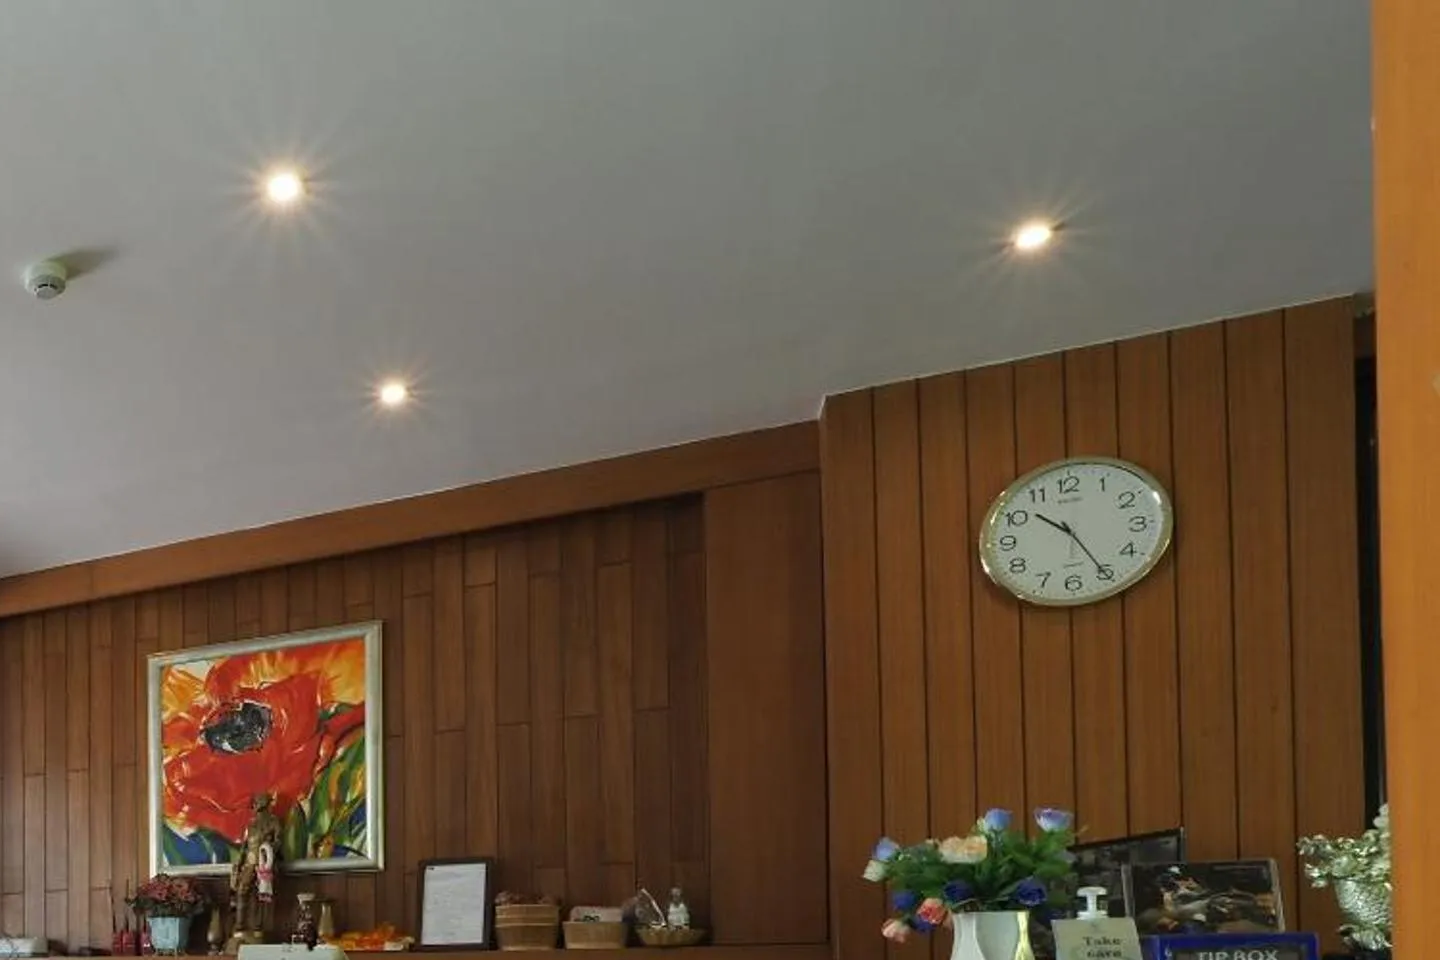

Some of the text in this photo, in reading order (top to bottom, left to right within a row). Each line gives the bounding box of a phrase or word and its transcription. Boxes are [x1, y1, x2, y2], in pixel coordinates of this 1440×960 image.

[1057, 475, 1080, 494] 12
[1099, 477, 1106, 492] 1
[1029, 487, 1047, 503] 11
[1118, 491, 1136, 509] 2
[1005, 510, 1028, 527] 10
[1128, 515, 1147, 532] 3
[999, 535, 1017, 551] 9
[1120, 541, 1138, 558] 4
[1009, 557, 1027, 574] 8
[1035, 571, 1052, 588] 7
[1064, 575, 1083, 591] 6
[1083, 936, 1121, 946] Take
